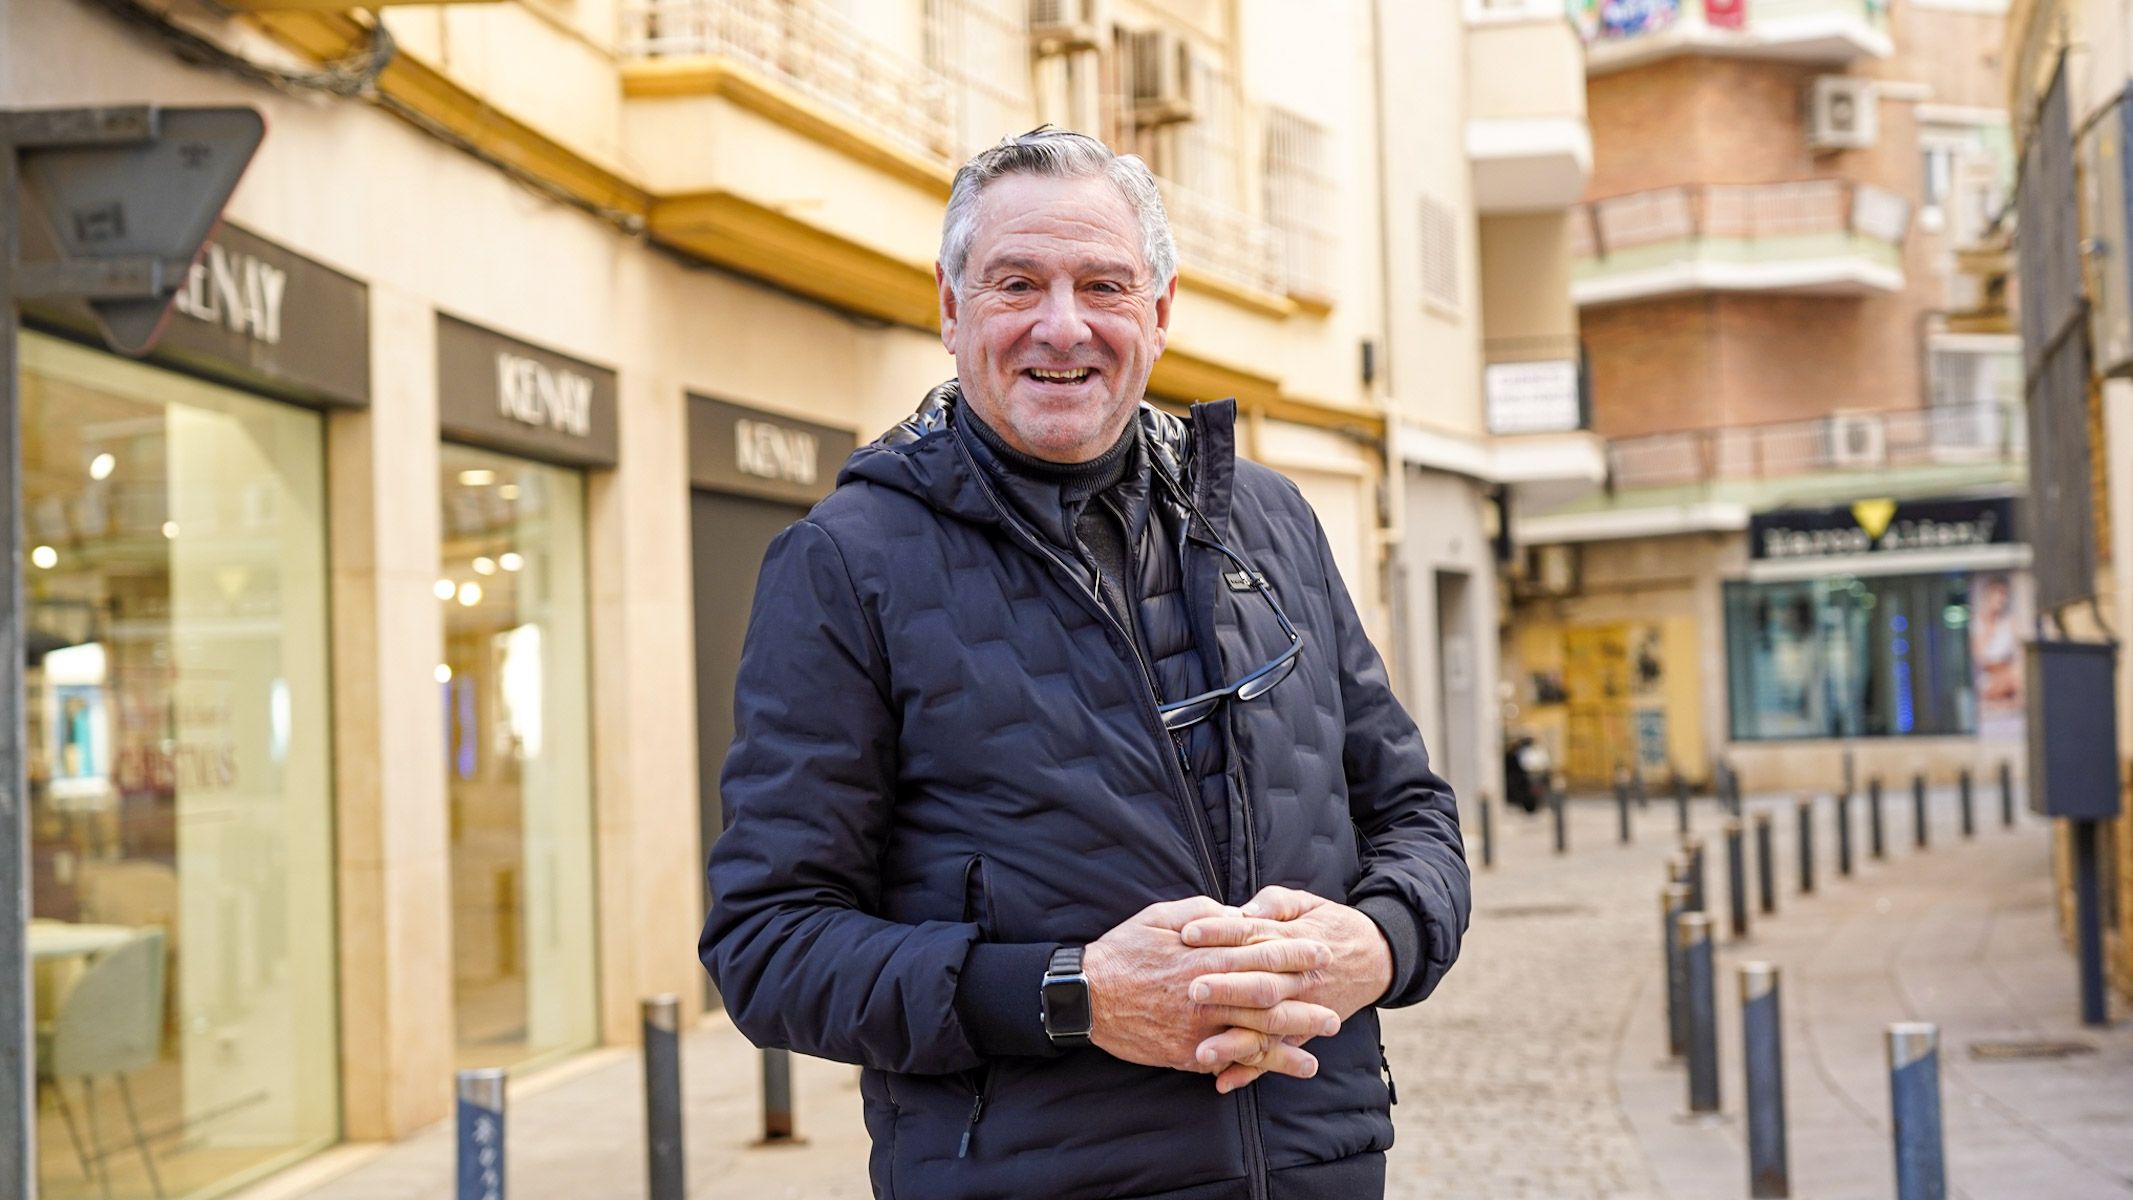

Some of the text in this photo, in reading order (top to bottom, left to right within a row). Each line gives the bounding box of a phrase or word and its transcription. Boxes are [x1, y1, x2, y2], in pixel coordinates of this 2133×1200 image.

[174, 243, 286, 344] ENAY
[496, 352, 594, 437] KENAY
[735, 418, 819, 486] KENAY
